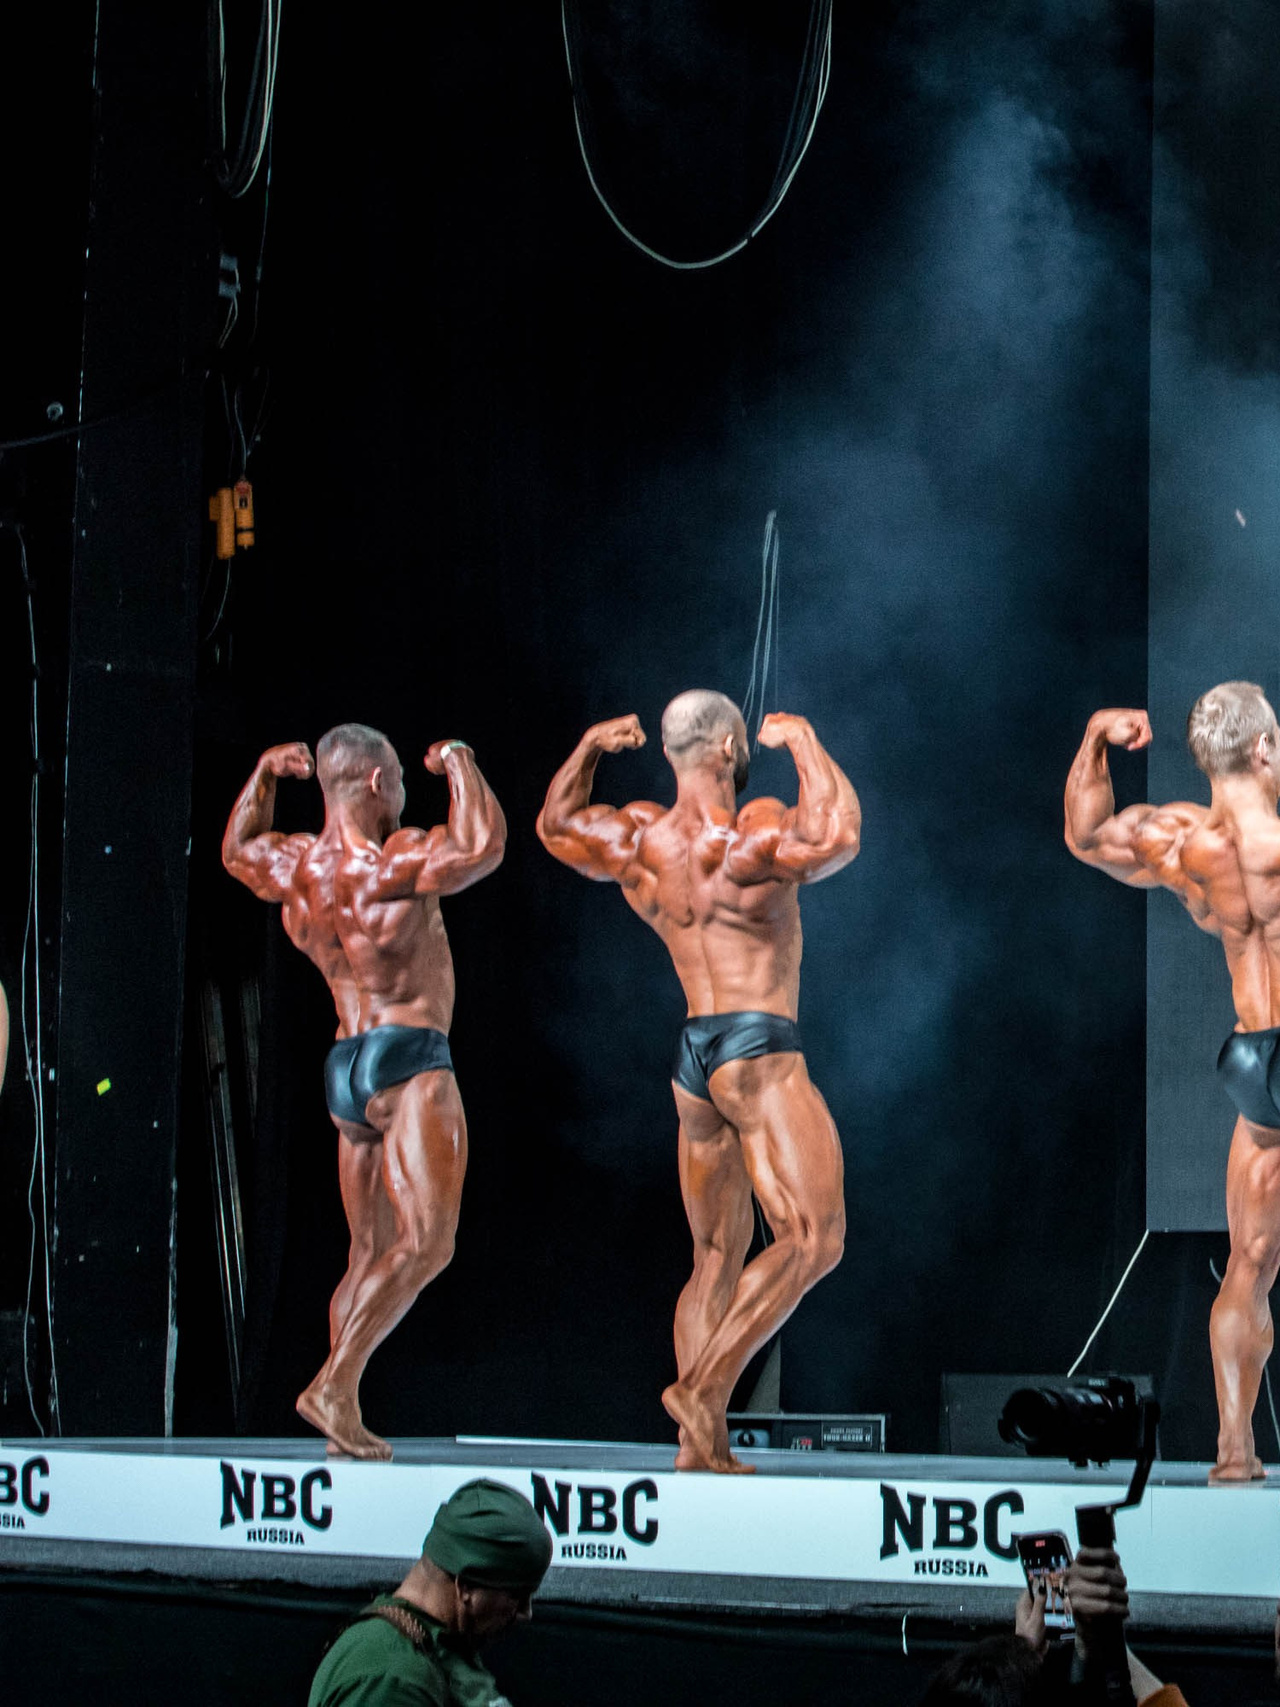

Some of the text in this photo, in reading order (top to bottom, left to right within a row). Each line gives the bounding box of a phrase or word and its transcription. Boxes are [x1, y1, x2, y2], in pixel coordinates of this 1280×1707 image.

[219, 1459, 333, 1533] NBC
[530, 1470, 659, 1547] NBC
[246, 1526, 305, 1545] RUSSIA
[879, 1480, 1025, 1562] NBC
[561, 1542, 628, 1562] RUSSIA
[914, 1558, 990, 1578] RUSSIA
